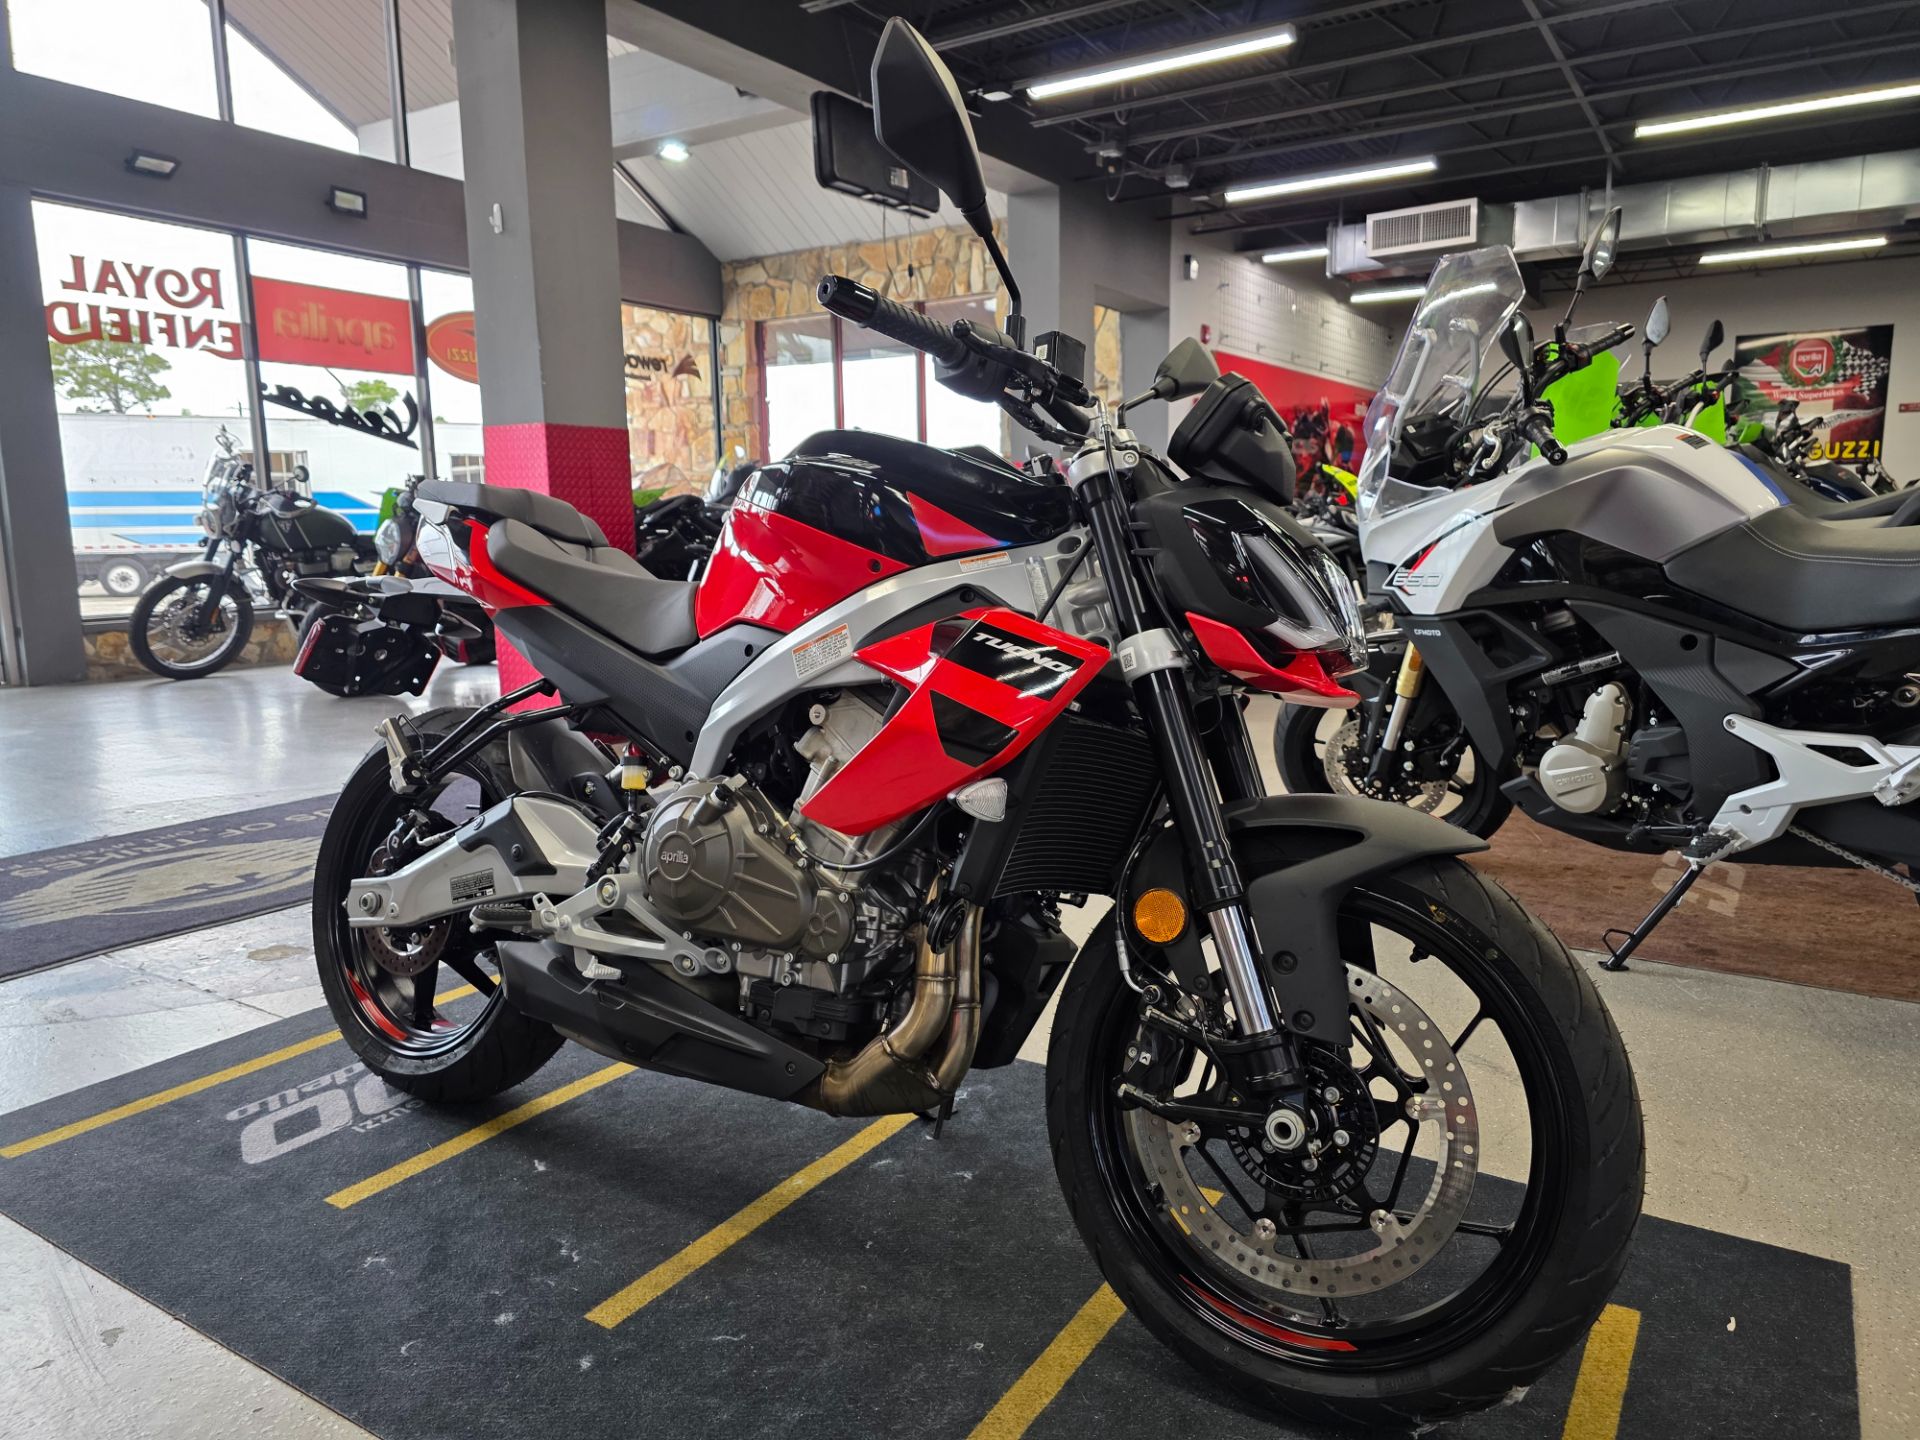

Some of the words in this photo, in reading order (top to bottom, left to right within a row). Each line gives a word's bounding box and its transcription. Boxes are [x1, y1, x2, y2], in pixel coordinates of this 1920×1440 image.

[1797, 352, 1822, 363] aprilia
[1773, 388, 1797, 400] World
[1799, 387, 1845, 401] Superbikes
[1808, 440, 1880, 459] GUZZI
[1413, 628, 1442, 637] CFMOTO
[973, 632, 1073, 673] TUONO
[218, 822, 277, 838] OF
[10, 838, 208, 878] TRIKES
[660, 850, 688, 864] aprilia
[351, 1099, 425, 1133] GUZZI
